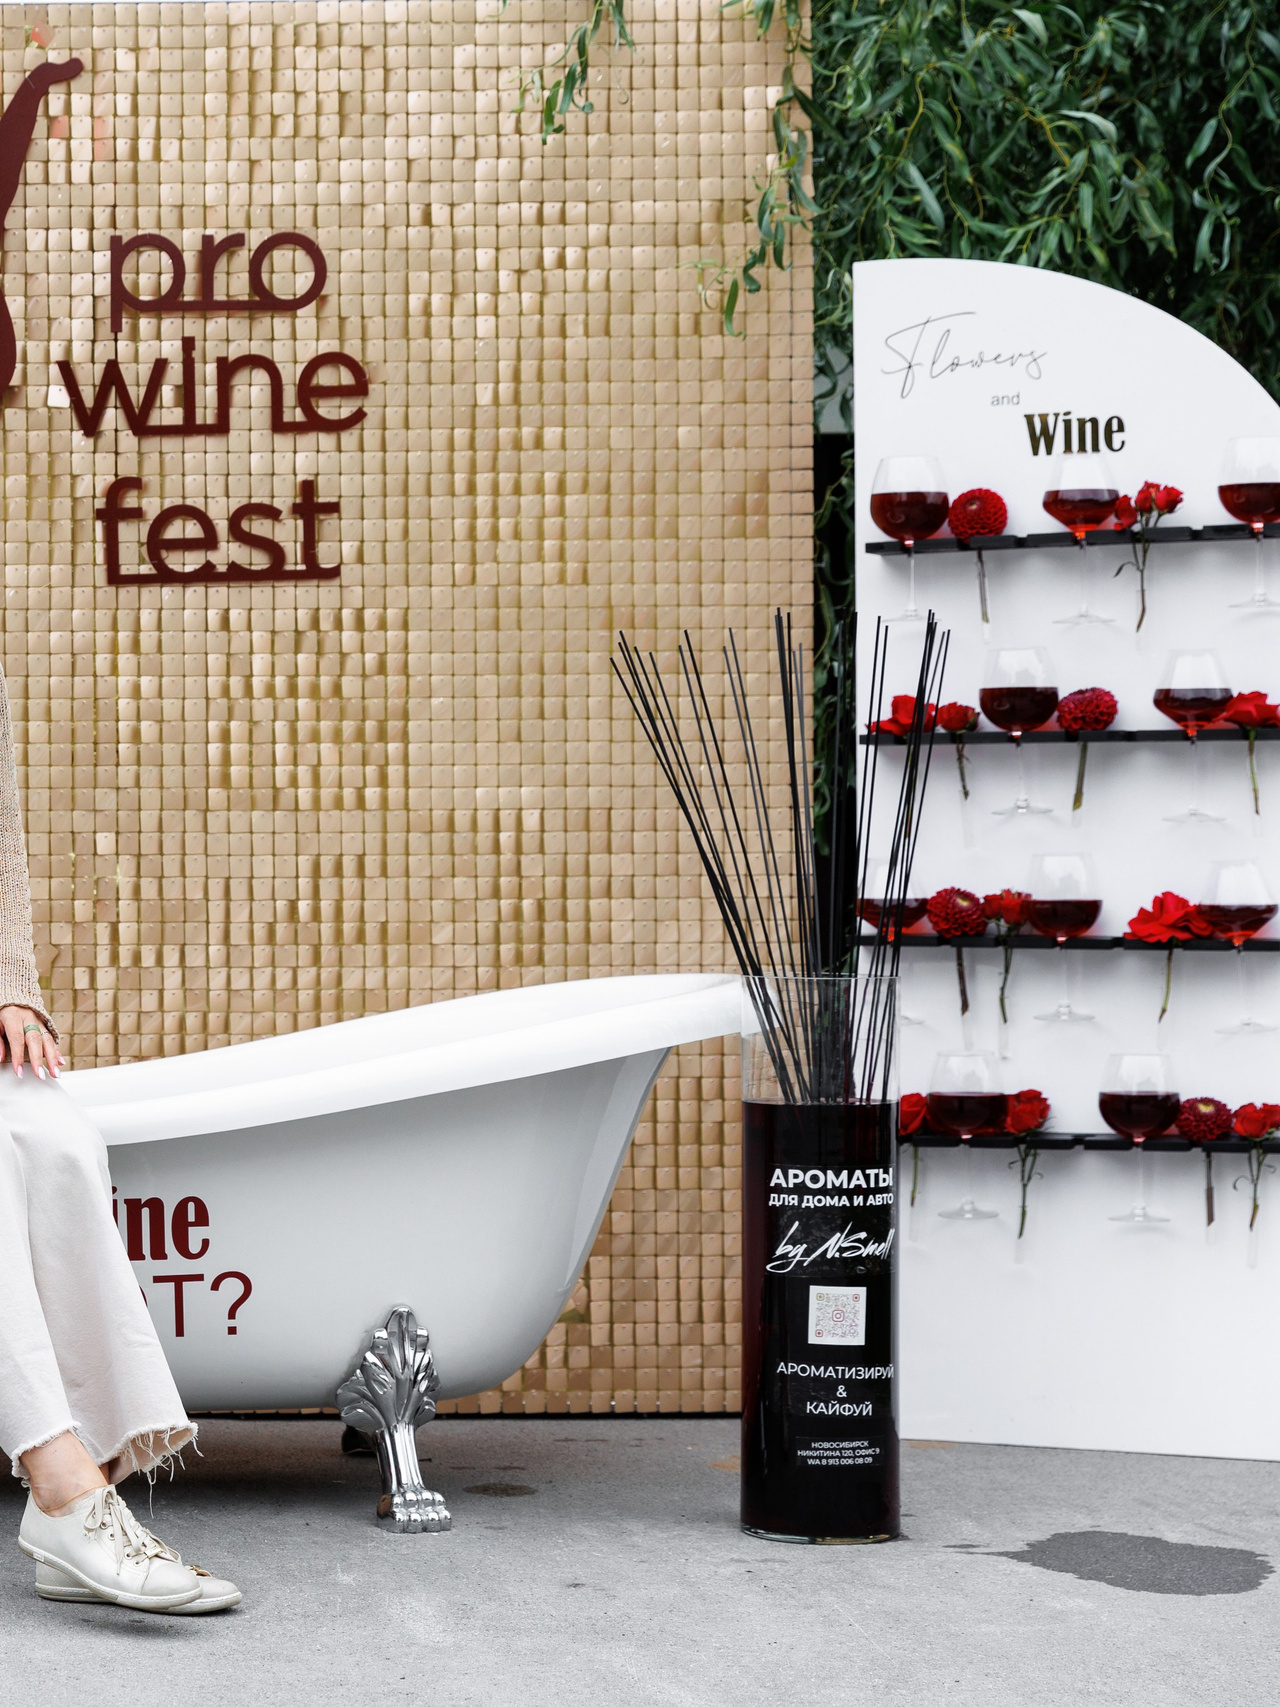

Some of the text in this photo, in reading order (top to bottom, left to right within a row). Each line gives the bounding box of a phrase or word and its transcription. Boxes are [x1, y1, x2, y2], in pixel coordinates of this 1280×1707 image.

[110, 231, 328, 333] pro
[881, 311, 1048, 399] Flowers
[56, 336, 370, 438] wine
[990, 392, 1021, 406] and
[1023, 411, 1126, 456] Wine
[95, 476, 341, 585] fest
[769, 1167, 893, 1189] АРОМАТЫ
[768, 1193, 894, 1208] ДЛЯ ДОМА И АВТО
[766, 1220, 808, 1273] by
[139, 1271, 253, 1338] T?
[776, 1361, 894, 1380] АРОМАТИЗИРУЙ
[836, 1385, 847, 1398] &
[806, 1400, 873, 1416] КАЙФУЙ
[811, 1440, 869, 1449] НОВОСИБИРСК
[855, 1448, 876, 1456] ОФИС
[875, 1447, 880, 1455] 9
[827, 1458, 840, 1466] 913
